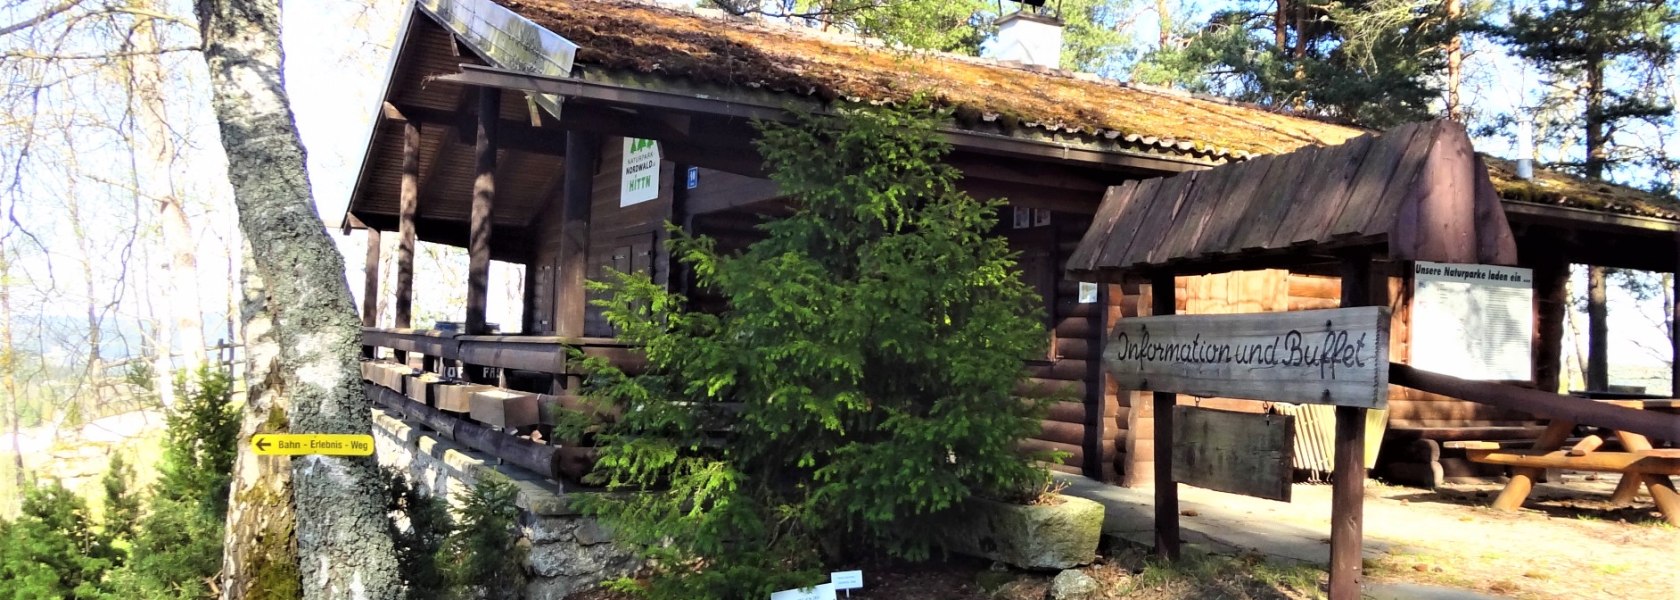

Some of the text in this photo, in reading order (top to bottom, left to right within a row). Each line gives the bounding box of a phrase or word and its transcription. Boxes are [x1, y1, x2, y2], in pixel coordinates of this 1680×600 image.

[627, 151, 654, 164] NATURPARK
[1415, 264, 1441, 276] Unsere
[1444, 266, 1486, 280] Naturparke
[1488, 270, 1508, 281] laden
[1510, 272, 1521, 282] ein
[1118, 329, 1367, 380] Information und Buffet
[278, 440, 301, 449] Bahn
[310, 440, 342, 449] Erlebnis
[351, 441, 368, 451] Weg
